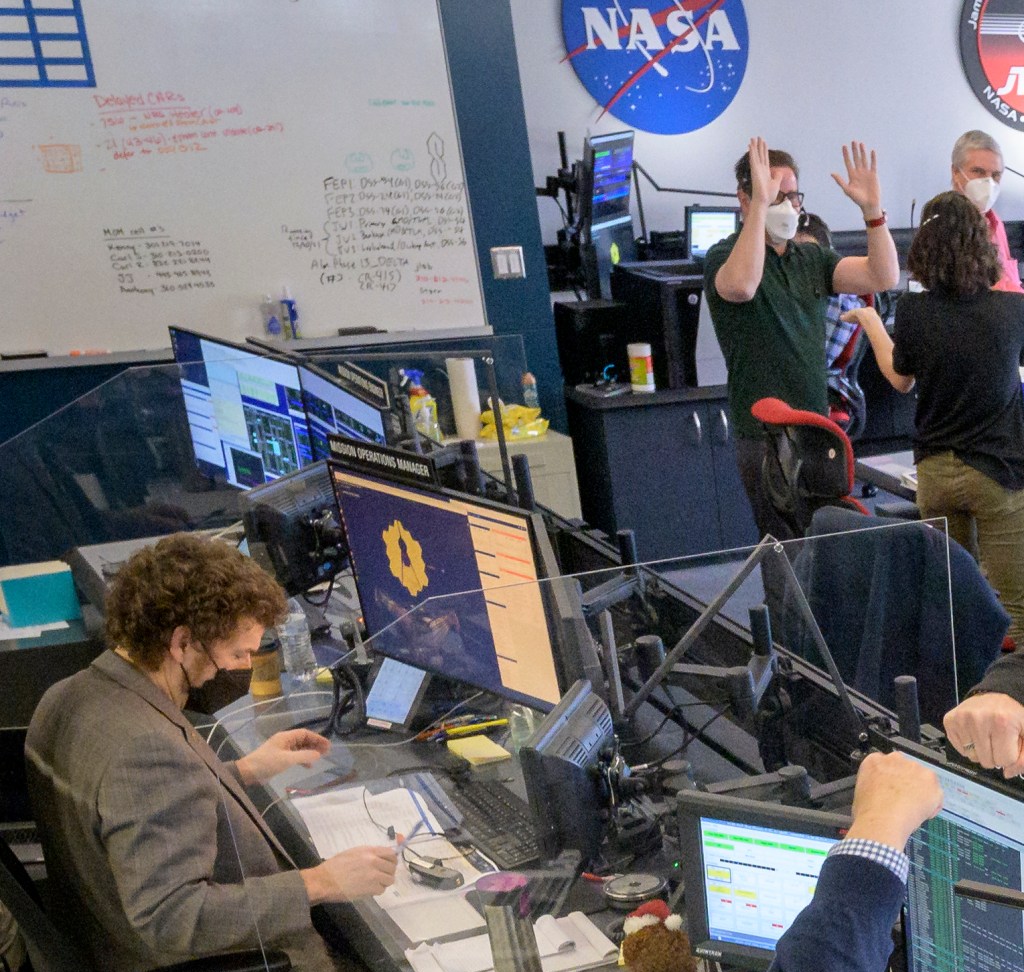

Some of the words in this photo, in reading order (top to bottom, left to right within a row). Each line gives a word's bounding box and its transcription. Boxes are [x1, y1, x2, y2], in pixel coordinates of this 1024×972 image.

[581, 7, 741, 54] NASA
[983, 85, 1018, 122] NASA
[330, 440, 357, 457] MISSION
[356, 447, 397, 469] OPERATIONS
[396, 458, 430, 477] MANAGER
